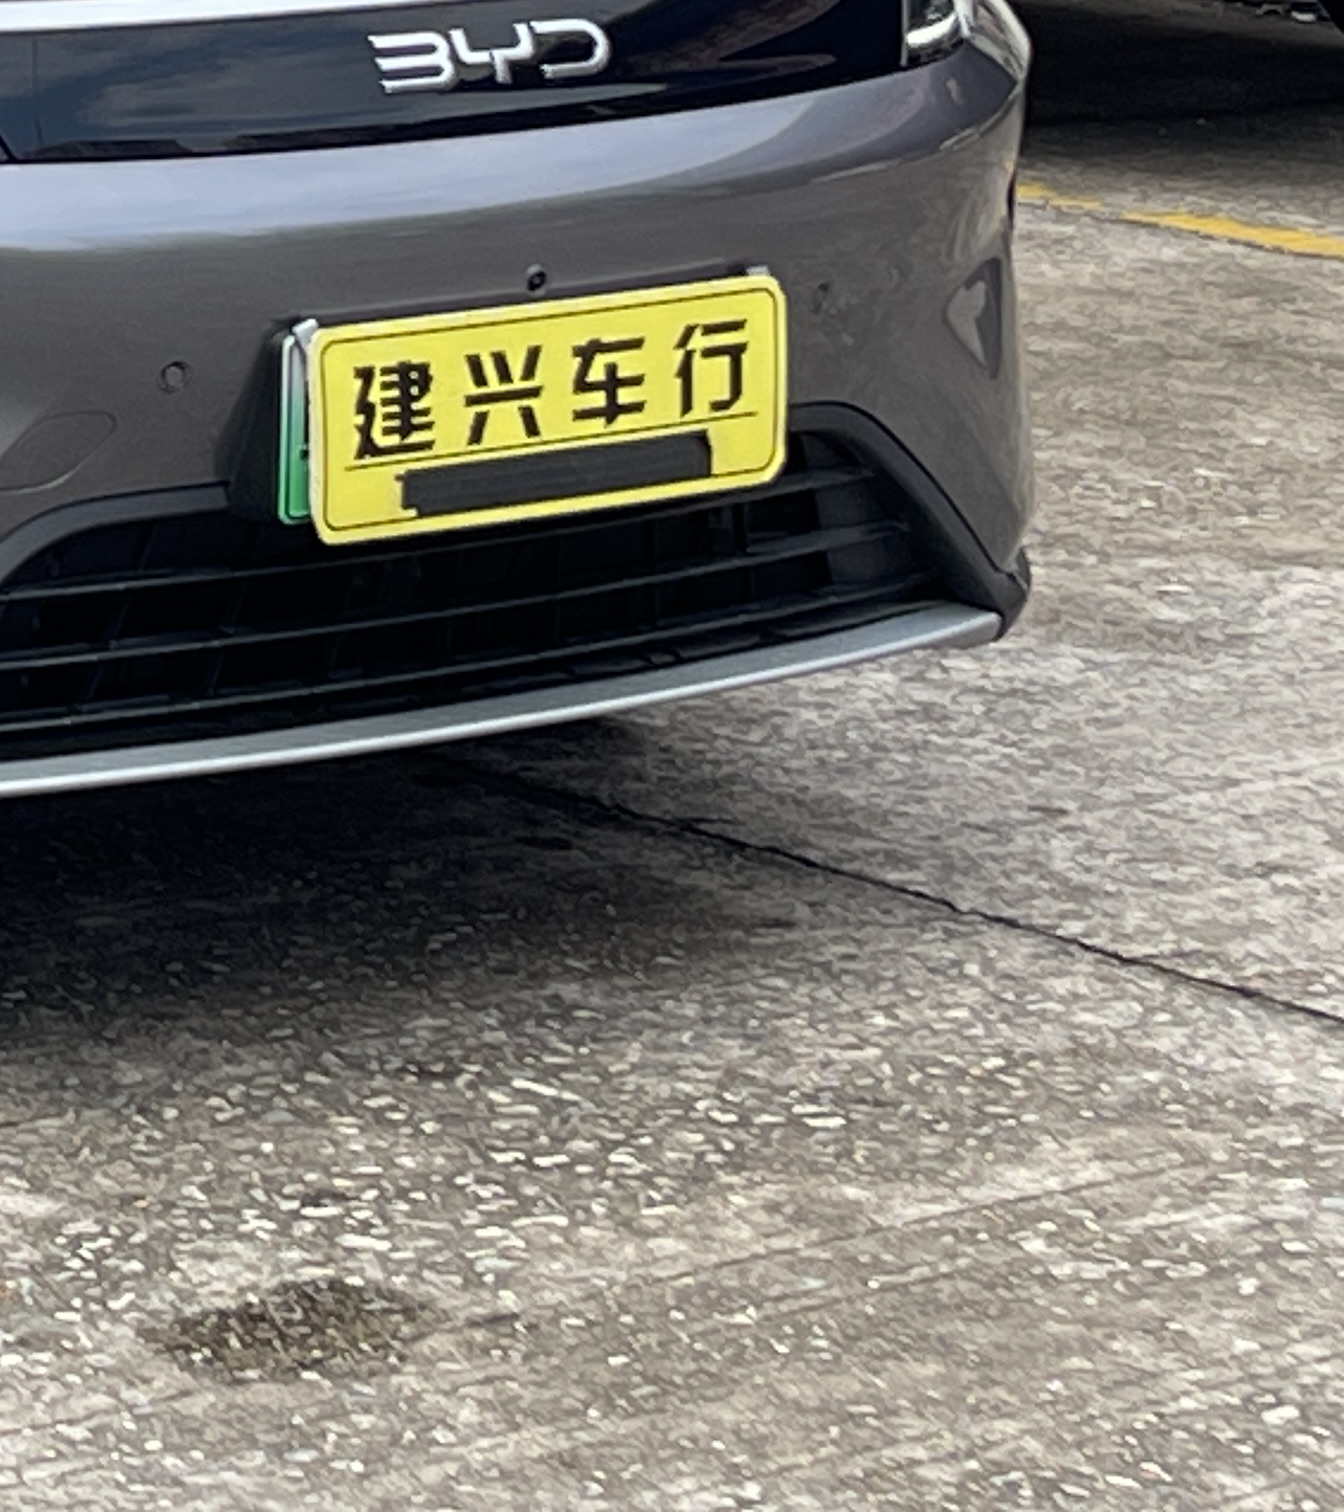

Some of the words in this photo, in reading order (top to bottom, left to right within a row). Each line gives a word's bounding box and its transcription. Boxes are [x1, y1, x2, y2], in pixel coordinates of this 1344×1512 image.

[367, 18, 610, 94] BYD
[353, 318, 749, 460] 建兴车行
